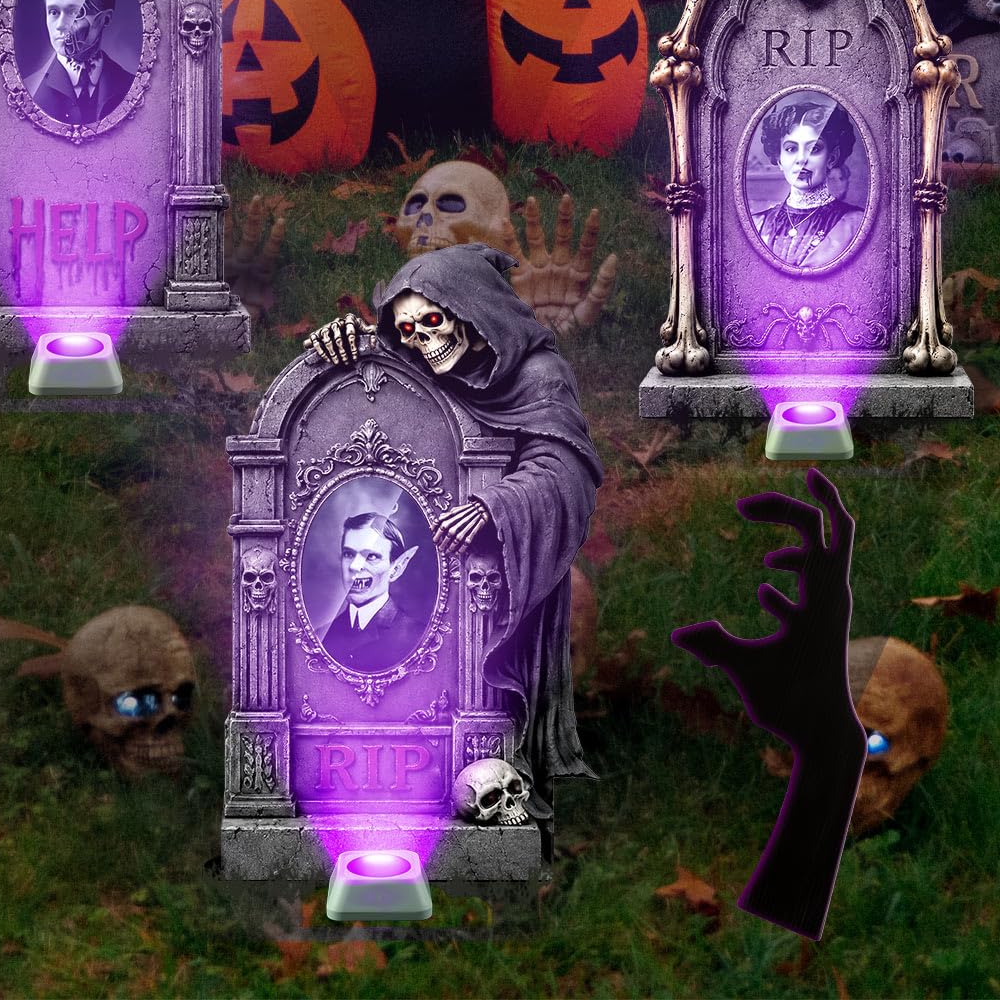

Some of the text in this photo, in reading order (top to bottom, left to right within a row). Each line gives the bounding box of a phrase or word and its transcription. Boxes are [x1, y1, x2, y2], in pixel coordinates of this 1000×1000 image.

[761, 29, 853, 67] RIP
[9, 196, 148, 270] HELP
[314, 744, 430, 791] RIP
